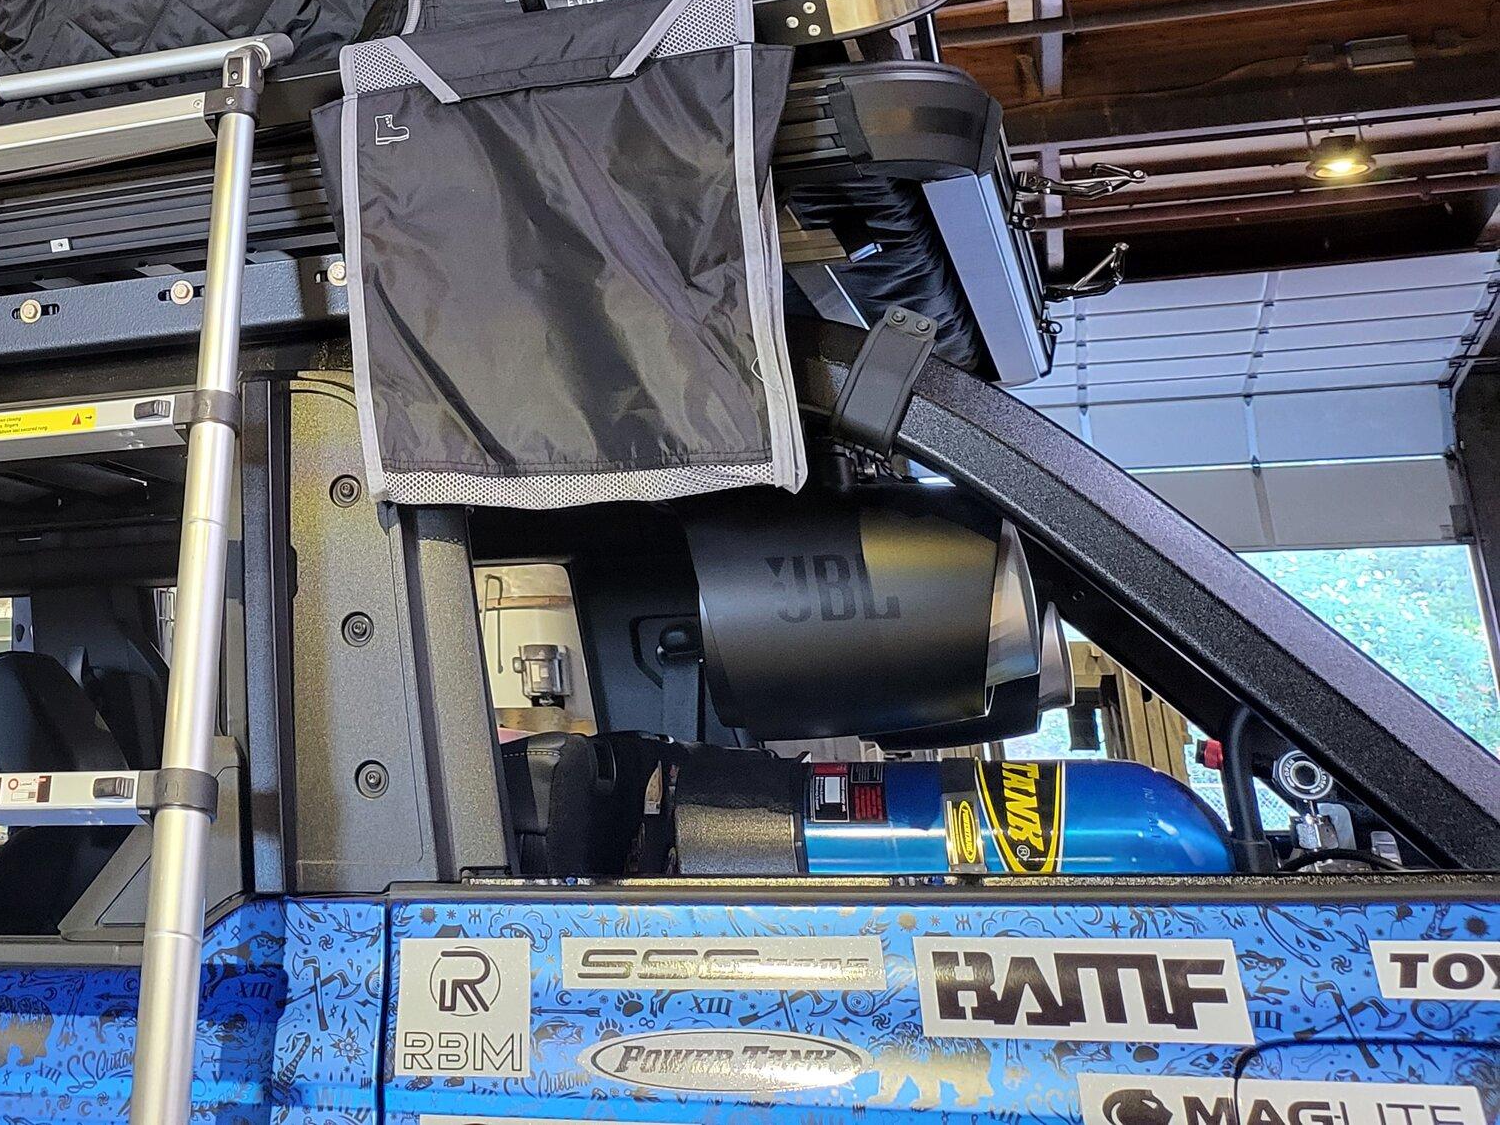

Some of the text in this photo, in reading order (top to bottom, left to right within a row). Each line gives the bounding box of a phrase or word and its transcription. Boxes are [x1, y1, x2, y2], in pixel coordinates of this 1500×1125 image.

[765, 554, 901, 623] JBL
[1001, 762, 1045, 852] TANK
[688, 993, 734, 1017] XIII
[403, 1031, 523, 1072] RBM
